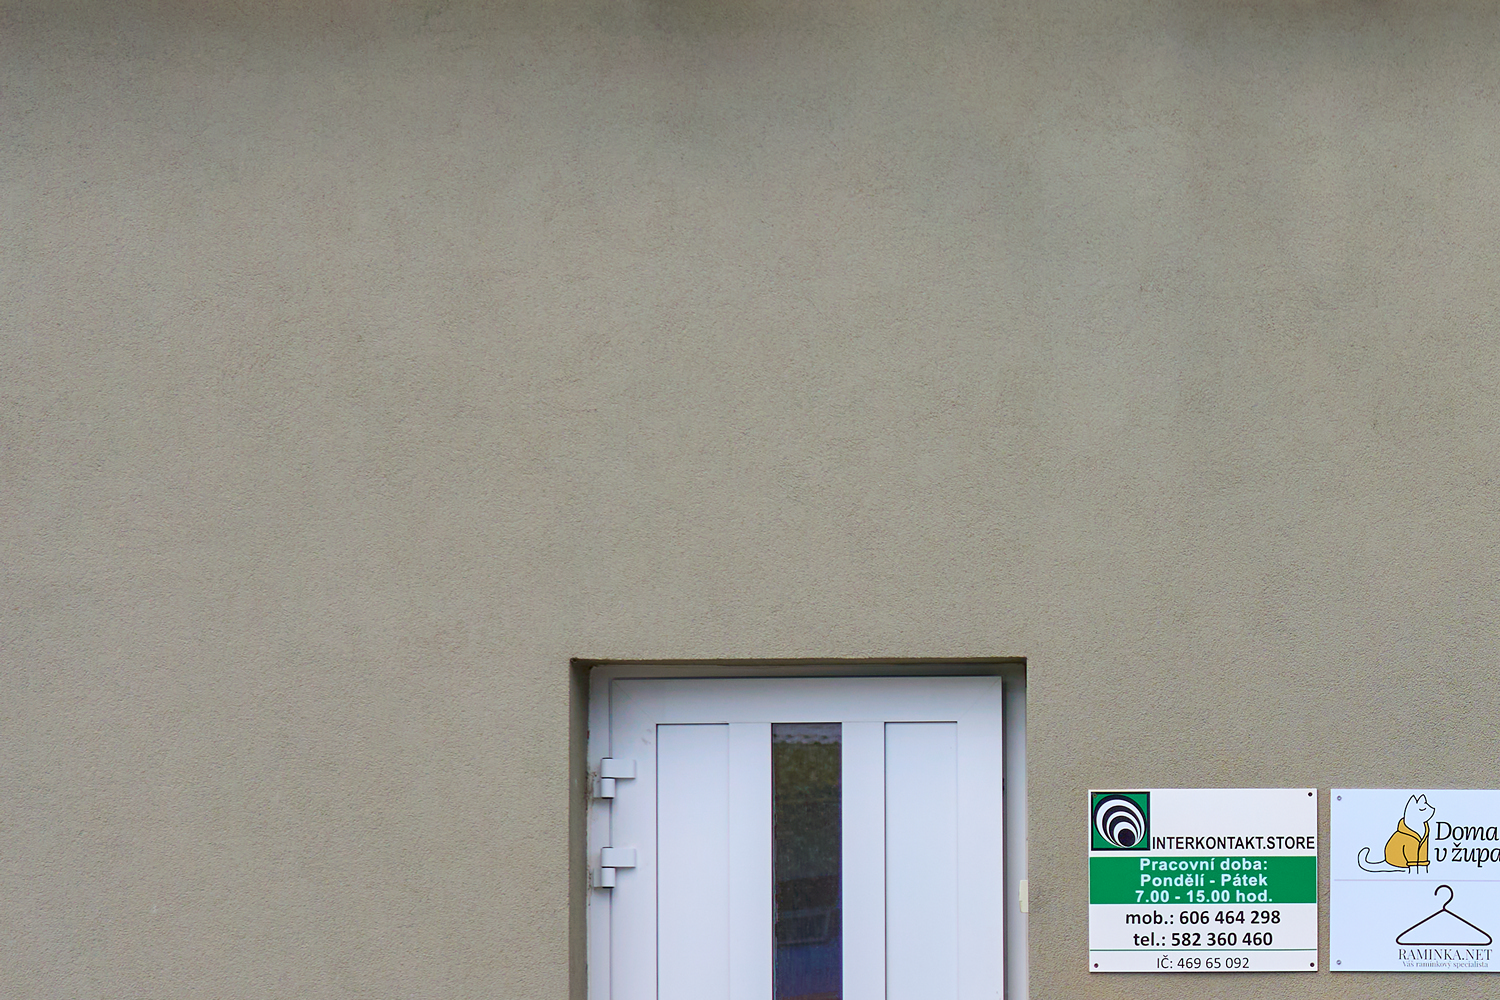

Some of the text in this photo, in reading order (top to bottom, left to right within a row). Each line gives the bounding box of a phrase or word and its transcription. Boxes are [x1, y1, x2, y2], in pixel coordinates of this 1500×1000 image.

[1434, 821, 1499, 841] Doma
[1152, 836, 1315, 850] INTERKONTAKT.STORE
[1434, 847, 1447, 862] v
[1139, 858, 1268, 871] Pracovní doba:
[1140, 873, 1205, 887] Pondělí
[1221, 873, 1268, 887] Pátek
[1135, 890, 1170, 903] 7.00
[1186, 890, 1231, 903] 15.00
[1236, 889, 1273, 902] hod.
[1125, 910, 1281, 925] mob.: 606 464 298
[1133, 932, 1273, 947] tel.: 582 360 460
[1398, 948, 1493, 961] RAMINKA.NET
[1156, 955, 1250, 969] IČ: 469 65 092
[1453, 960, 1489, 969] specialista
